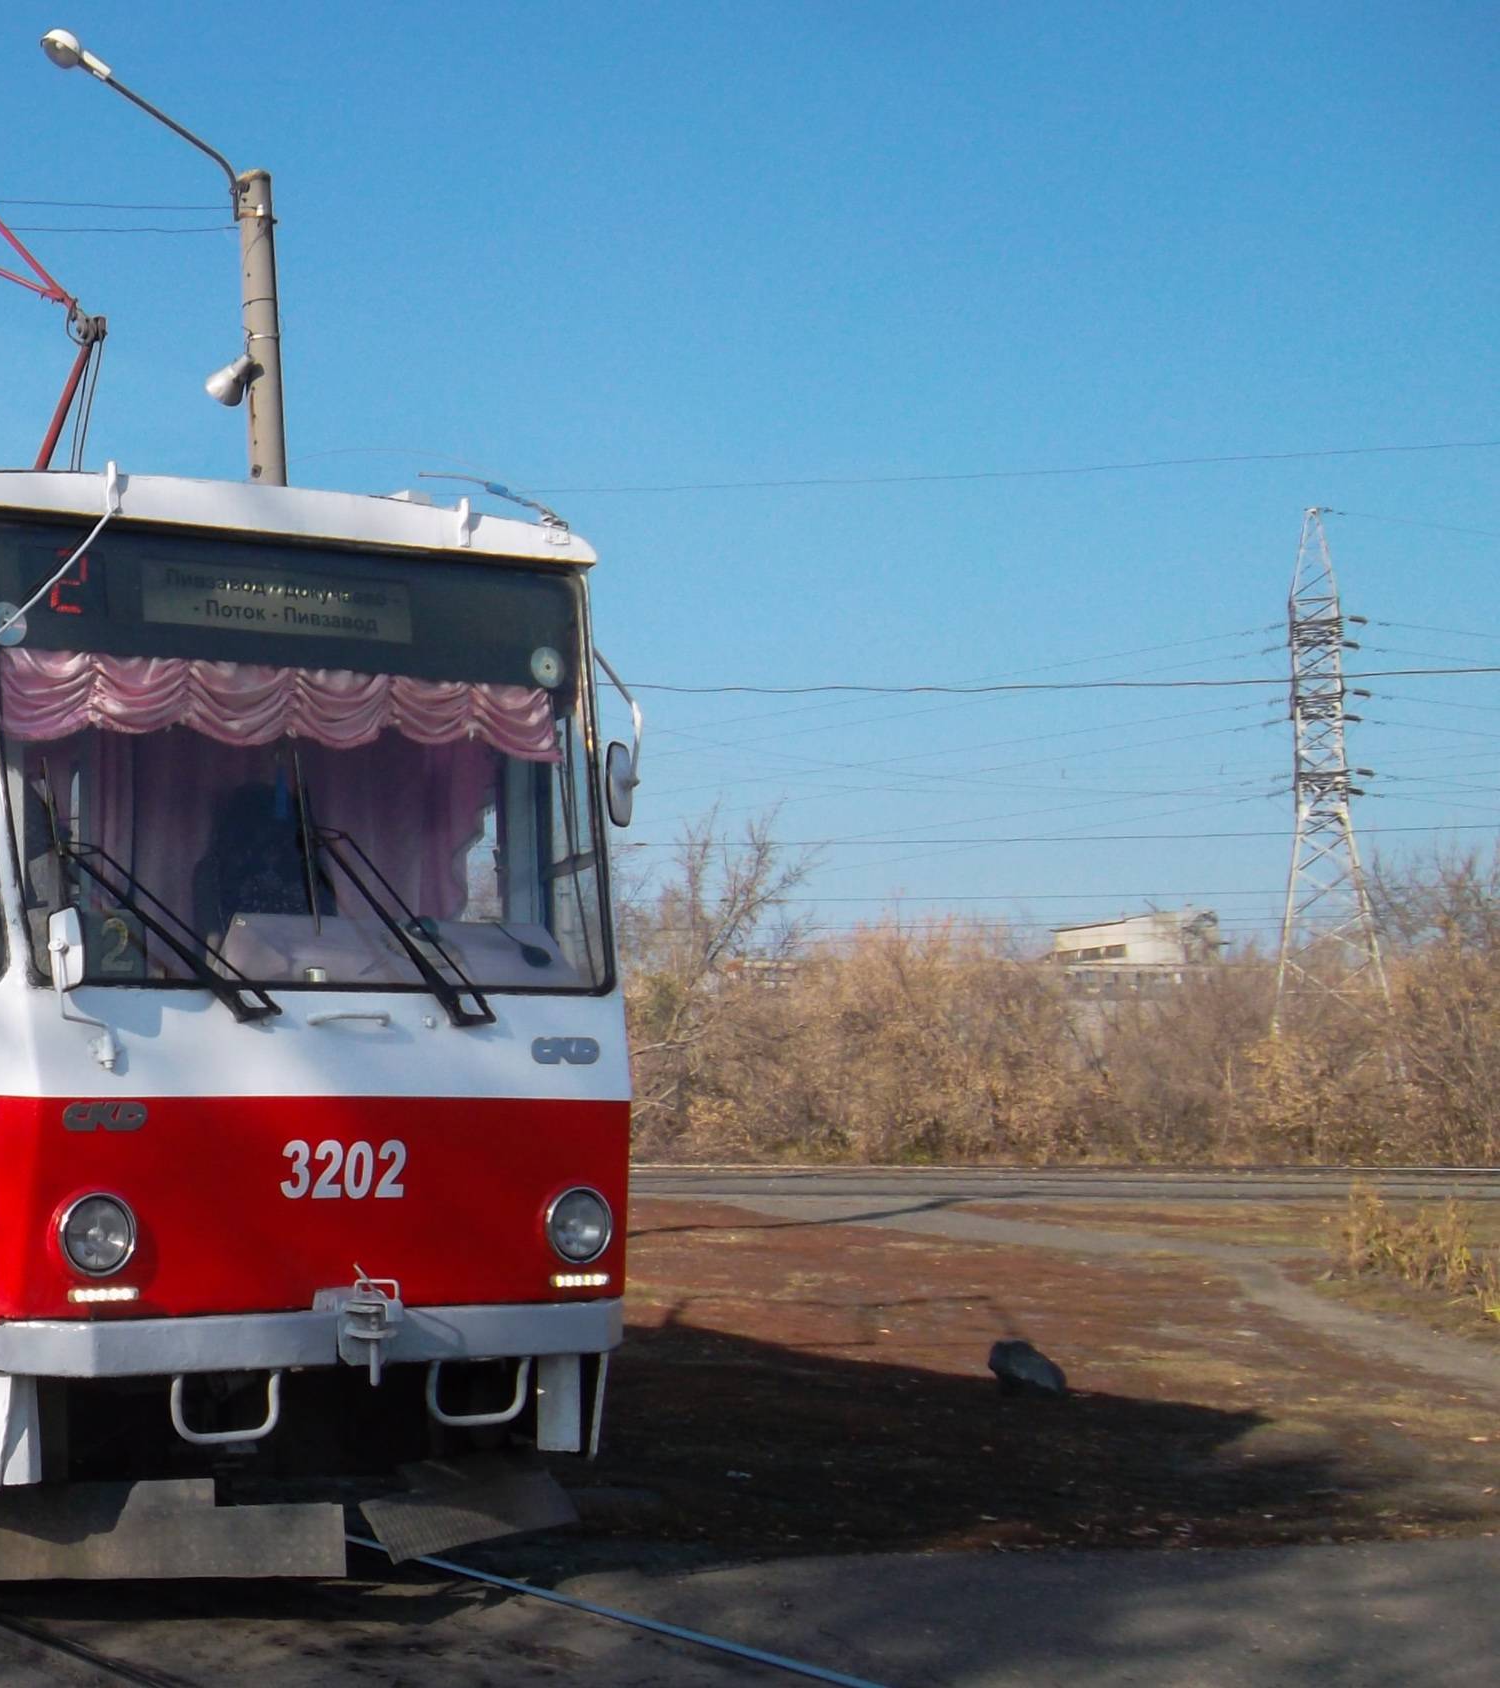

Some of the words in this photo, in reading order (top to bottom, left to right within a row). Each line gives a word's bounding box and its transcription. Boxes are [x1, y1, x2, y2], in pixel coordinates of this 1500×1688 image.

[50, 547, 88, 614] 2
[206, 600, 266, 621] Поток
[283, 606, 379, 634] Пивзавод
[101, 917, 134, 972] 2
[280, 1139, 407, 1200] 3202
